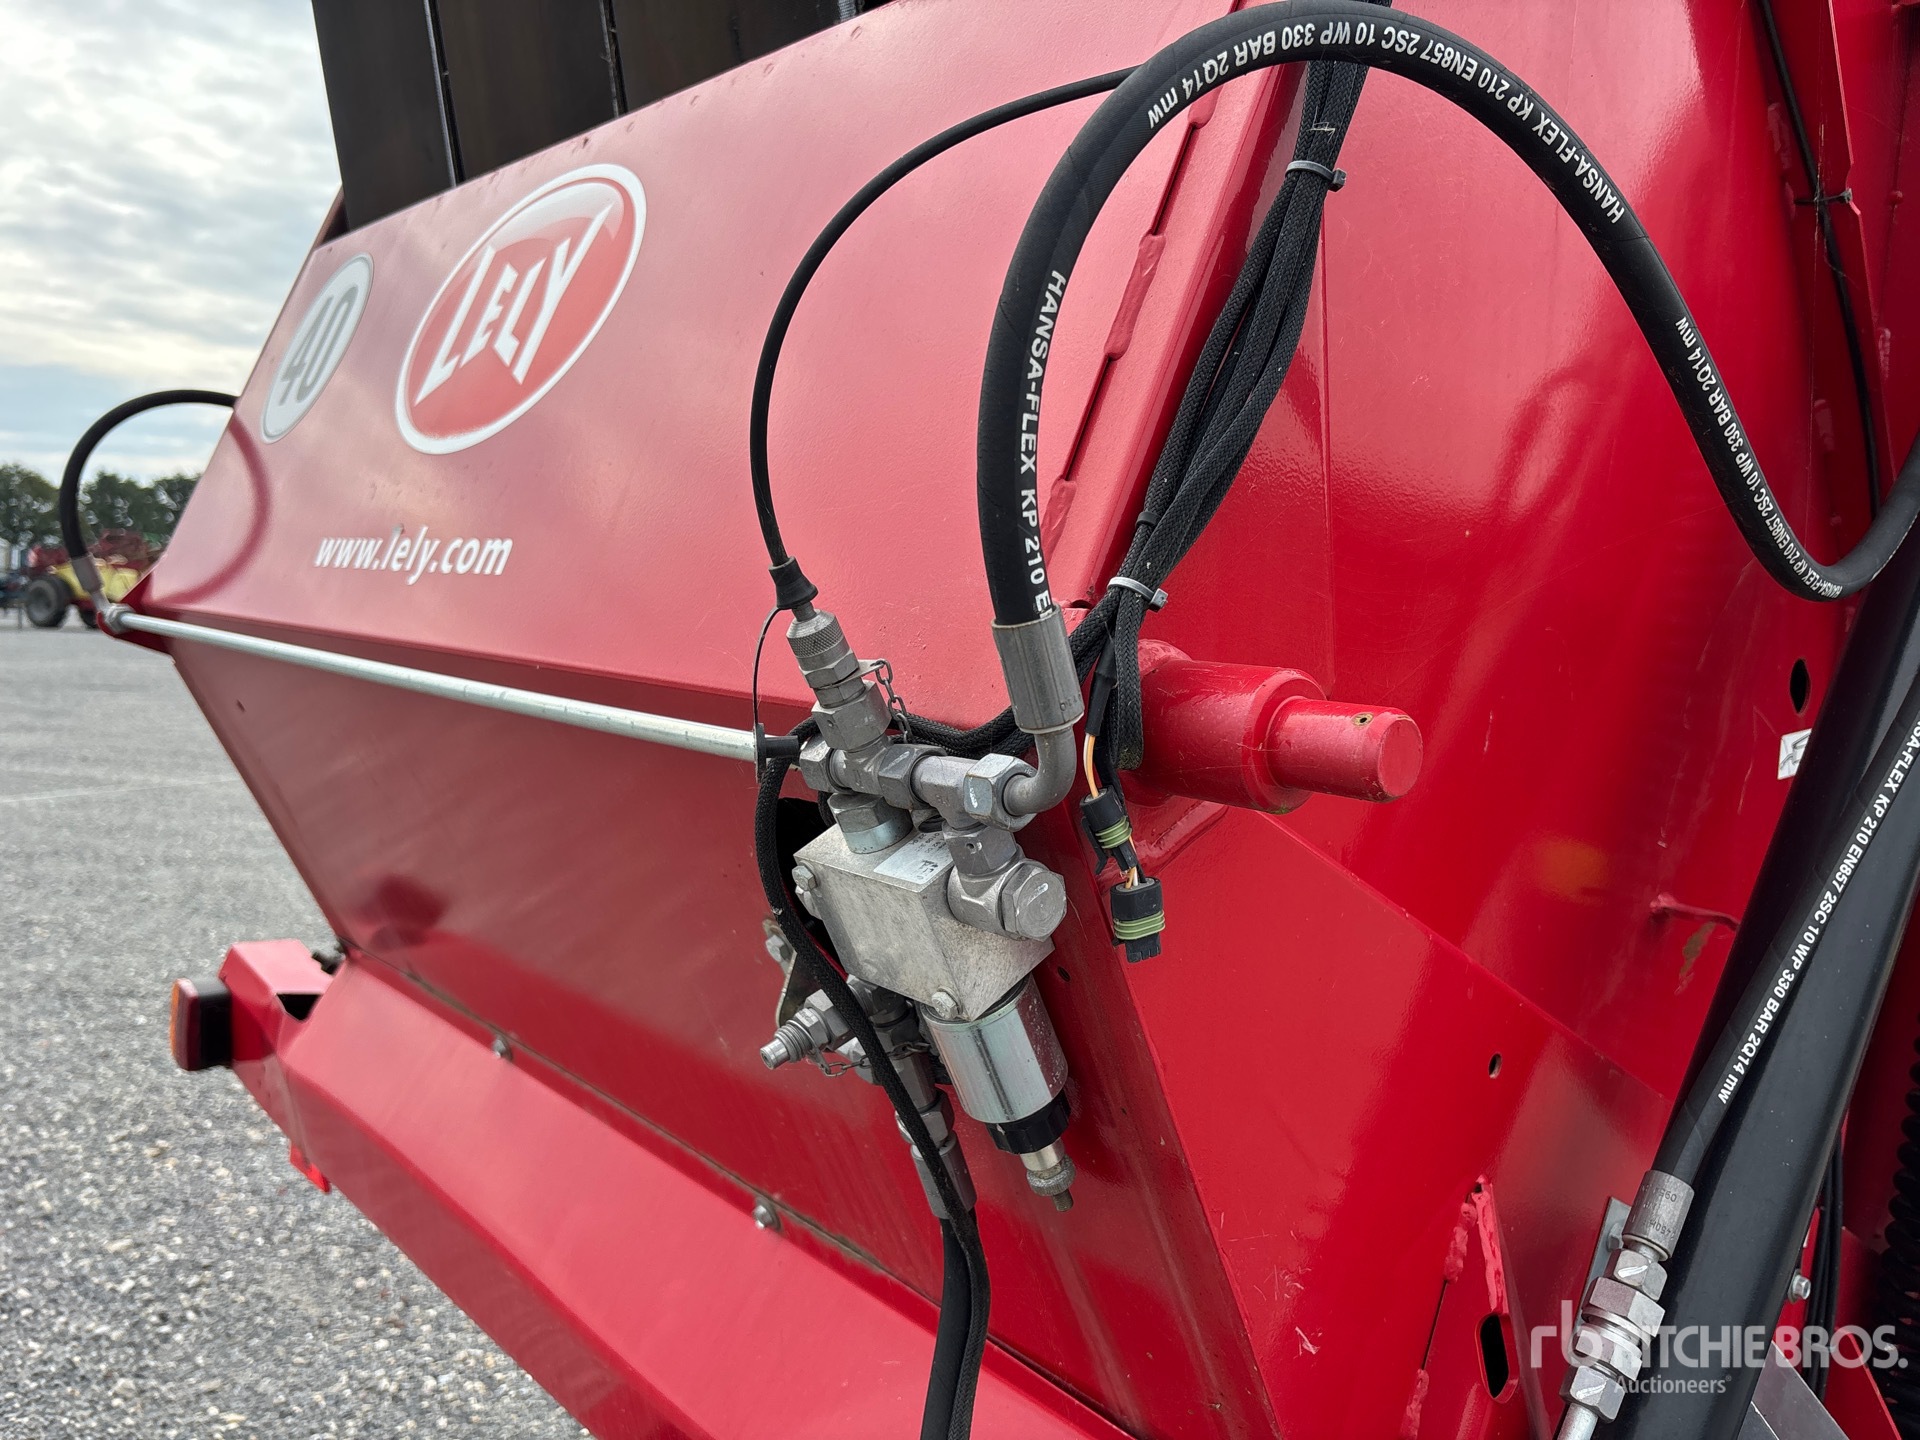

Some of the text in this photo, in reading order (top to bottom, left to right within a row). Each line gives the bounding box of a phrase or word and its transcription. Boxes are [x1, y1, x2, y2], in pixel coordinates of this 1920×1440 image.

[1233, 31, 1276, 67] BAR
[1281, 23, 1315, 50] 330
[1320, 22, 1350, 45] WP
[1355, 23, 1375, 46] 10
[1381, 26, 1421, 56] 2SC
[1182, 51, 1229, 100] 2Q14
[1420, 39, 1478, 83] EN857
[1478, 68, 1510, 100] 210
[1506, 94, 1534, 121] KP
[1532, 112, 1625, 223] HANSA-FLEX
[415, 203, 613, 407] LELY
[280, 285, 359, 406] 40
[1021, 270, 1066, 475] HANSA-FLEX
[1687, 347, 1716, 391] 2Q14
[1708, 387, 1732, 427] BAR
[1724, 423, 1744, 453] 330
[1736, 451, 1752, 478] WP
[1746, 471, 1761, 491] 10
[1021, 489, 1037, 528] KP
[1754, 488, 1774, 517] 2SC
[1767, 512, 1792, 549] EN857
[314, 525, 513, 586] www.lely.com
[1023, 536, 1045, 585] 210
[1784, 544, 1800, 564] 210
[1793, 557, 1808, 576] KP
[1873, 792, 1890, 818] KP
[1856, 815, 1877, 845] 210
[1836, 843, 1863, 893] EN857
[1814, 890, 1837, 925] 2SC
[1803, 925, 1820, 945] 10
[1792, 942, 1809, 970] WP
[1773, 968, 1795, 999] 330
[1753, 997, 1779, 1035] BAR
[1733, 1031, 1761, 1076] 2Q14
